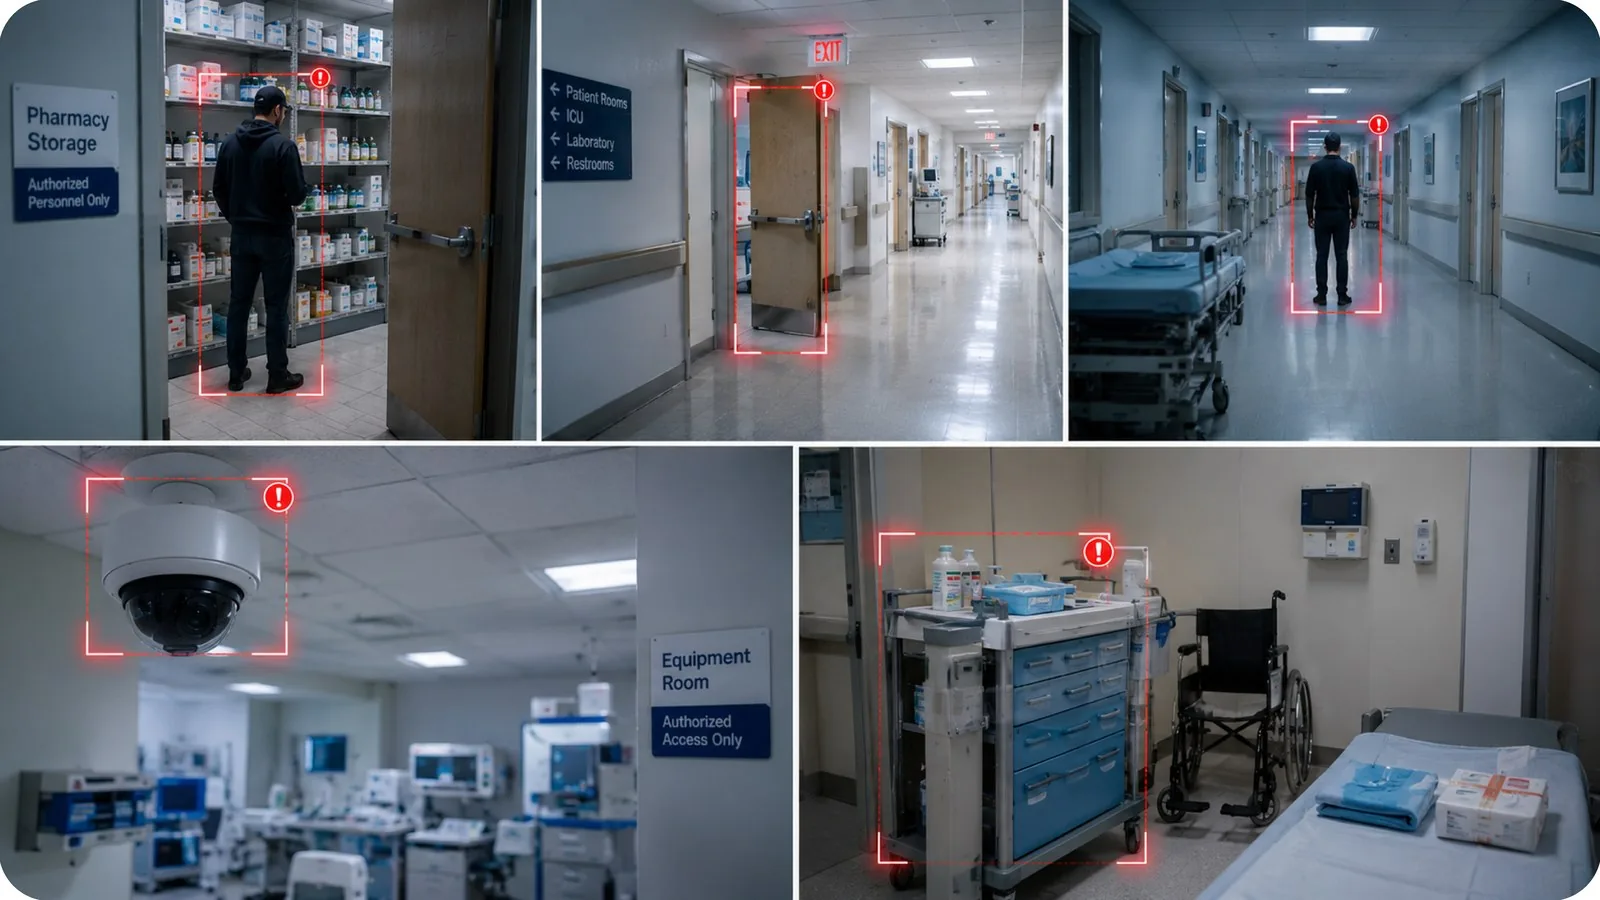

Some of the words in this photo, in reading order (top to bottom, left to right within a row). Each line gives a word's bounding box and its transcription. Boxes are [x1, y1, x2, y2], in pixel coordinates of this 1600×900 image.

[815, 40, 842, 62] EXIT
[566, 85, 599, 104] Patient
[601, 93, 628, 109] Rooms
[27, 106, 110, 131] Pharmacy
[567, 109, 583, 124] ICU
[28, 132, 97, 155] Storage
[567, 133, 615, 152] Laboratory
[567, 156, 614, 170] Restrooms
[28, 176, 89, 191] Authorized
[28, 194, 84, 209] Personnel
[87, 193, 110, 208] Only
[662, 648, 751, 671] Equipment
[662, 675, 709, 691] Room
[662, 714, 732, 729] Authorized
[662, 733, 708, 746] Access
[712, 733, 742, 749] Only
